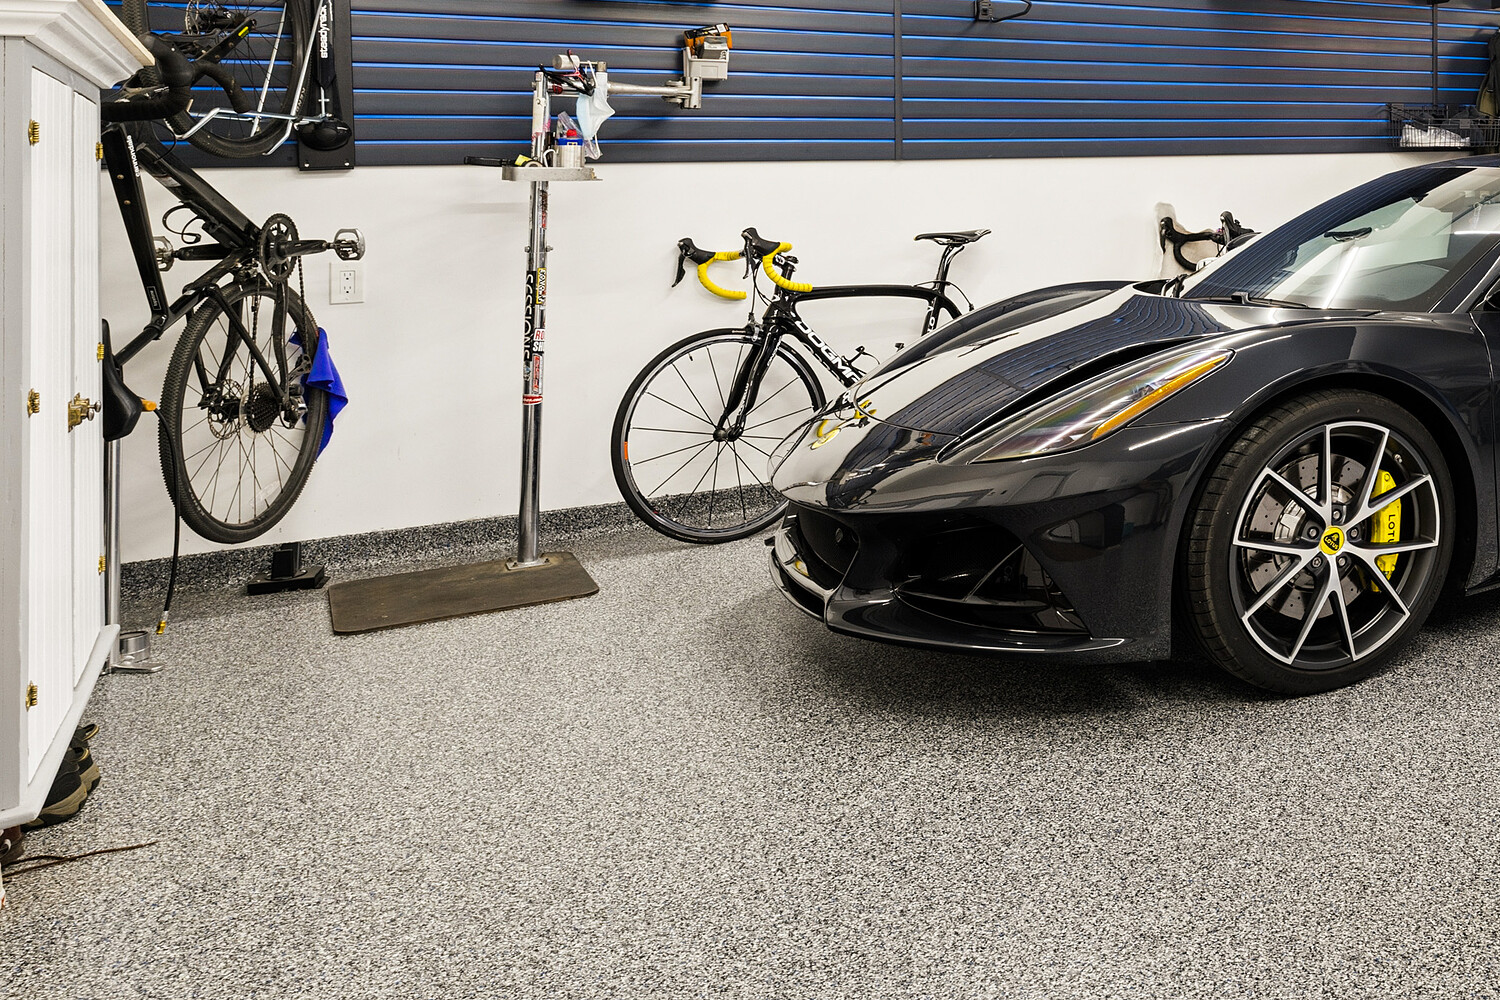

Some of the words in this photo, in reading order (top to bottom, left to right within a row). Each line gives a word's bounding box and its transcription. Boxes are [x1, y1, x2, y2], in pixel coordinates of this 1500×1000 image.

[320, 4, 330, 59] steadyrack
[127, 135, 140, 177] cannondale
[1324, 536, 1340, 550] LOTUS
[1387, 513, 1397, 544] LOTU
